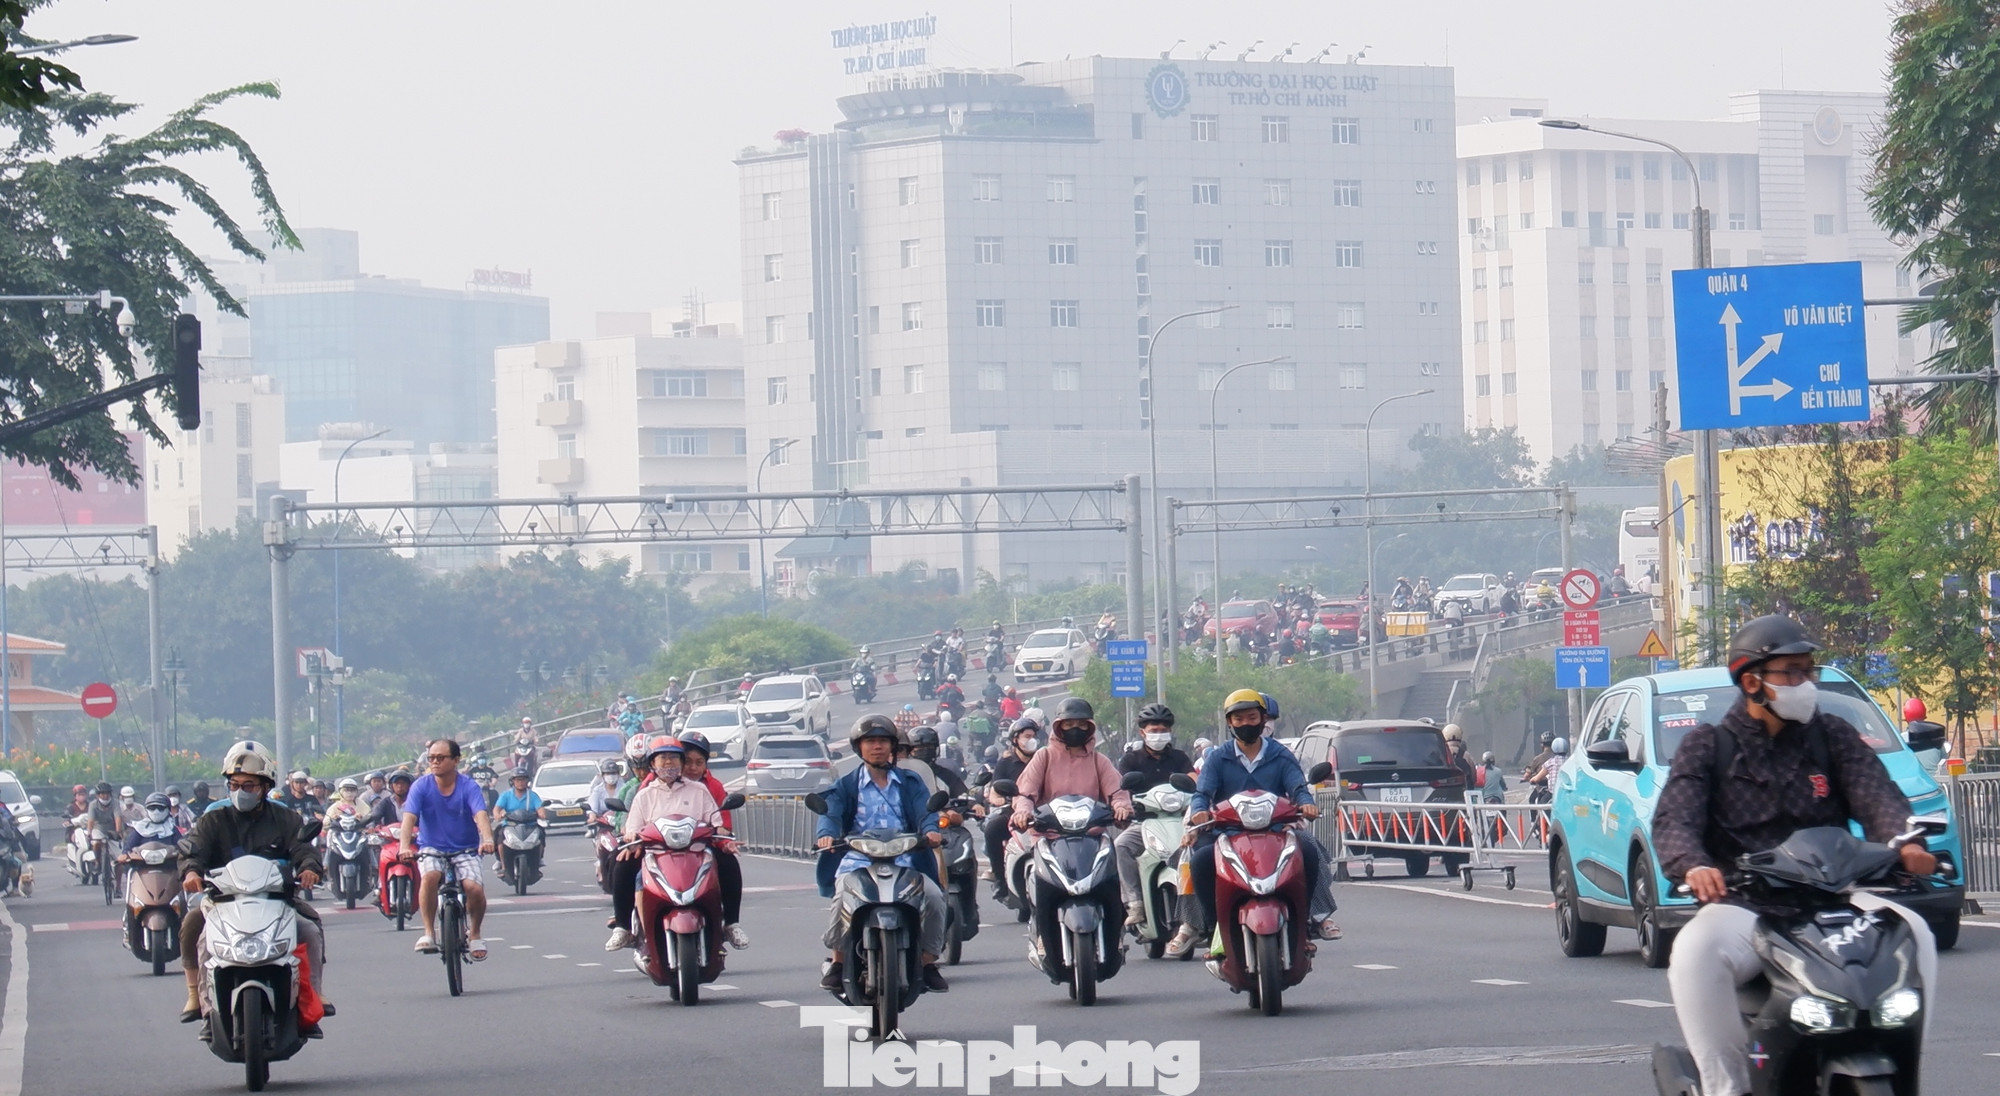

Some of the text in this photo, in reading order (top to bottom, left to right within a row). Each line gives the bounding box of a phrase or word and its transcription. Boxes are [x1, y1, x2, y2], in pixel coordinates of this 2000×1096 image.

[898, 47, 926, 67] MINH
[1195, 70, 1378, 93] TRƯỜNG ĐẠI HỌC LUẬT
[1275, 91, 1301, 107] CHÍ
[1305, 94, 1347, 107] MINH
[1708, 272, 1748, 296] QUẬN 4
[1784, 302, 1852, 326] VÕ VĂN KIỆT
[1819, 362, 1841, 385] CHỢ
[1802, 385, 1862, 409] BẾN THÀNH
[1665, 719, 1696, 728] TAXI
